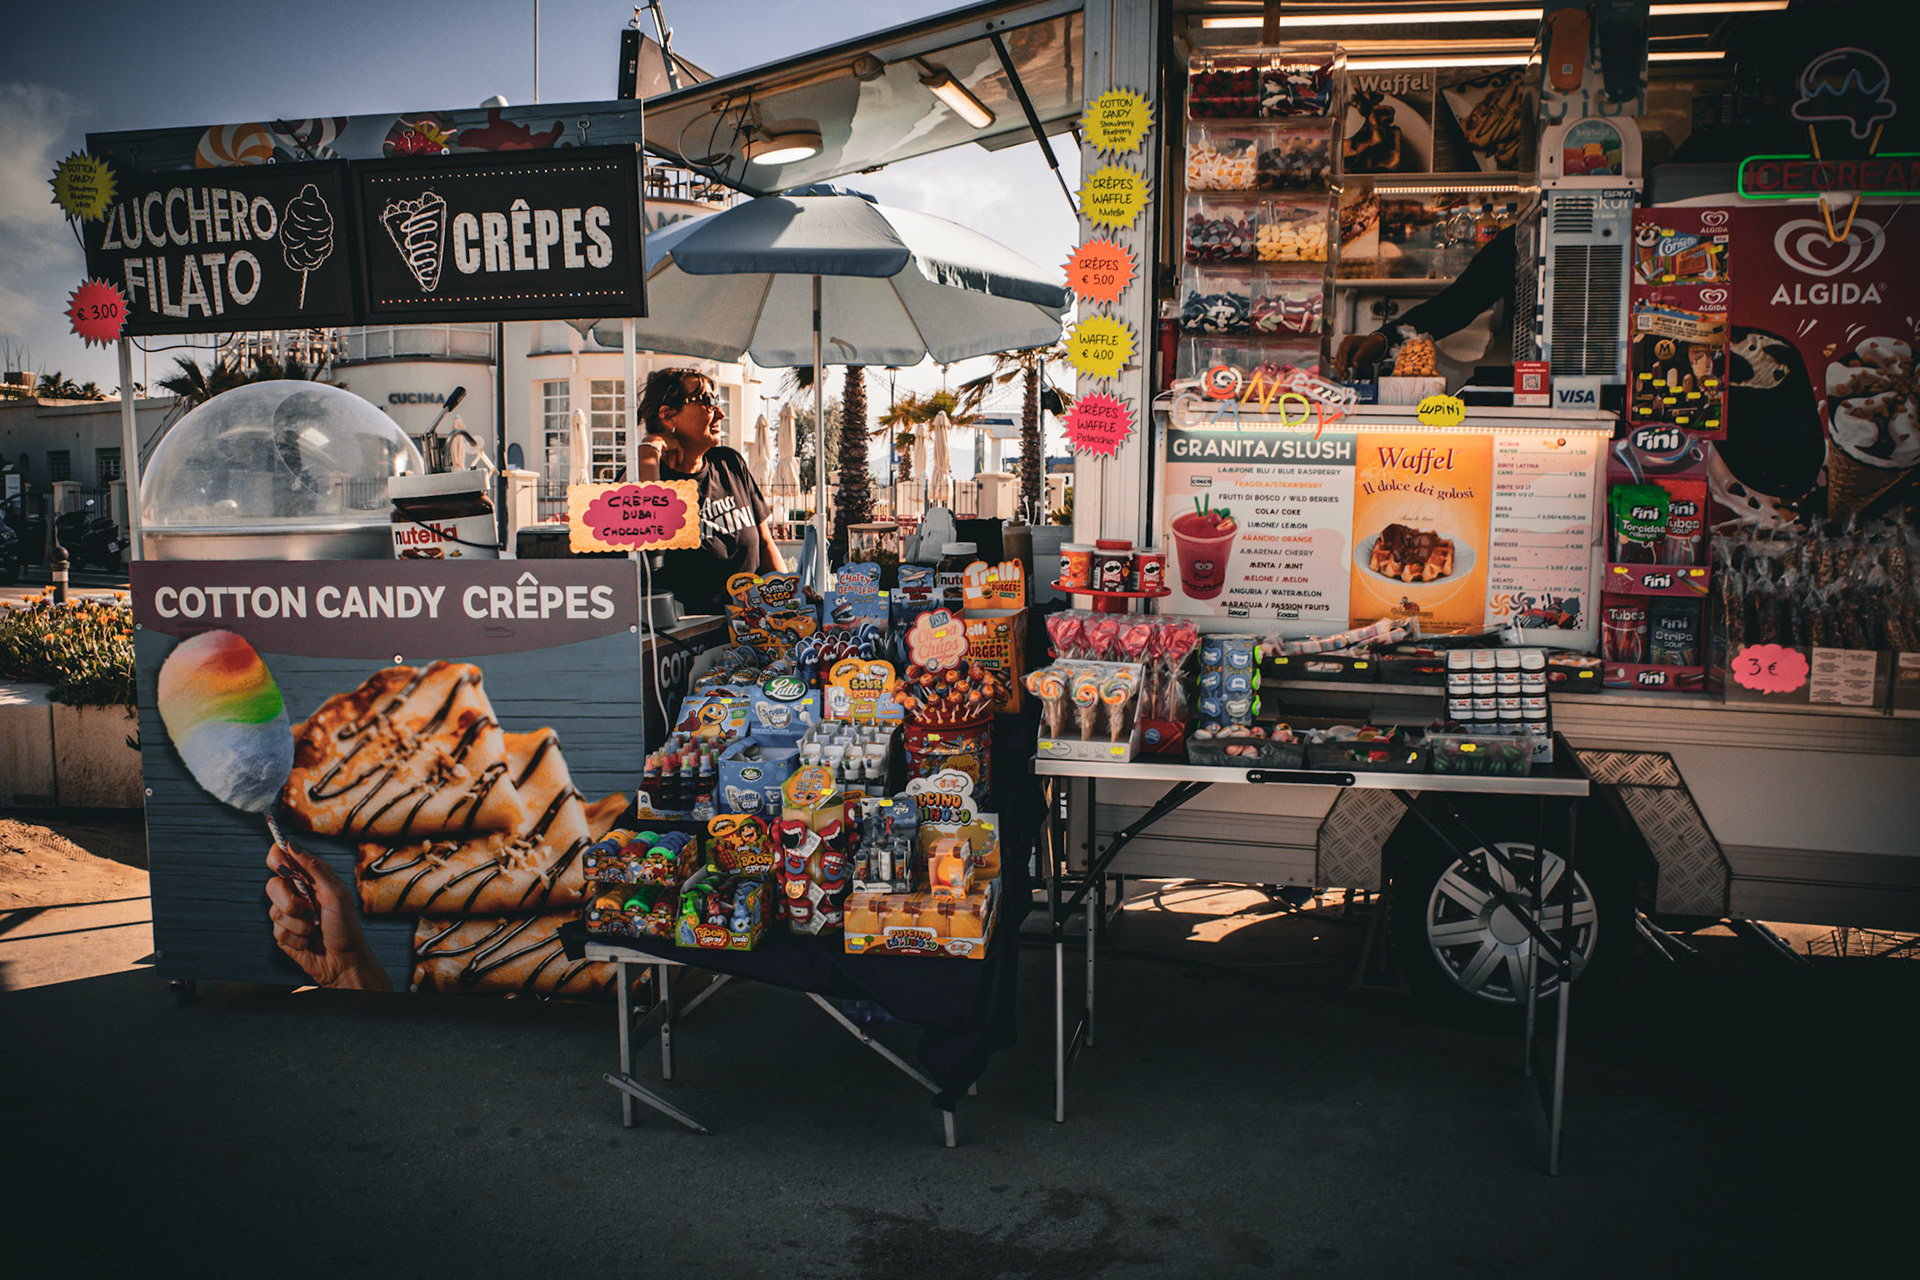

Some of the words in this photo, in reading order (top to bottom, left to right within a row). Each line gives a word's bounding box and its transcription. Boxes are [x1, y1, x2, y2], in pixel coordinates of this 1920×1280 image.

[1357, 74, 1429, 101] Waffel
[1100, 98, 1133, 109] COTTON
[1102, 108, 1131, 119] CANDY
[1099, 120, 1134, 129] Strawberry
[1102, 128, 1131, 137] Blueberry
[1108, 136, 1126, 144] White
[66, 163, 98, 175] COTTON
[69, 174, 96, 184] CANDY
[1093, 176, 1134, 190] CRÊPES
[1747, 161, 1803, 193] ICE
[66, 184, 99, 195] Strawberry
[1602, 189, 1633, 199] SPM
[70, 193, 97, 203] Blueberry
[1092, 193, 1133, 205] WAFFLE
[75, 200, 92, 209] White
[101, 186, 278, 251] ZUCCHERO
[1099, 208, 1125, 218] Nutella
[1700, 226, 1728, 234] ALGIDA
[452, 198, 614, 275] CRÊPES
[1658, 236, 1698, 256] Cornetto
[1079, 257, 1119, 271] CRÊPES
[122, 249, 262, 319] FILATO
[1082, 275, 1089, 285] €
[1769, 282, 1882, 306] ALGIDA
[1698, 304, 1728, 312] ALGIDA
[1079, 333, 1119, 346] WAFFLE
[1082, 350, 1089, 360] €
[388, 392, 446, 405] CUCINA
[1556, 389, 1596, 404] VISA
[1078, 403, 1119, 419] CRÊPES
[1077, 418, 1117, 433] WAFFLE
[1076, 432, 1115, 446] Pistacchio
[1637, 428, 1680, 450] Fini
[1172, 438, 1352, 461] GRANITA/SLUSH
[1376, 446, 1455, 476] Waffel
[1217, 466, 1255, 475] LAMPONE
[1256, 467, 1270, 475] BLU
[1278, 467, 1297, 475] BLUE
[1298, 468, 1342, 476] RASPBERRY
[1234, 480, 1324, 489] FRAGOLA/STRAWBERRY
[1361, 482, 1376, 495] Il
[1377, 479, 1411, 492] dolce
[1413, 482, 1435, 496] dei
[1437, 487, 1476, 502] golosi
[608, 490, 670, 508] CRÊPES
[1218, 493, 1244, 502] FRUTTI
[1245, 494, 1253, 502] DI
[1254, 494, 1280, 502] BOSCO
[1288, 495, 1308, 503] WILD
[1309, 495, 1339, 504] BERRIES
[1254, 508, 1280, 516] COLA/
[1281, 508, 1301, 516] COKE
[1631, 506, 1660, 521] Fini
[1668, 502, 1695, 516] Fini
[622, 510, 657, 521] DUBAI
[1247, 521, 1280, 529] LIMONE/
[1281, 522, 1308, 530] LEMON
[1621, 519, 1667, 534] Torcidas
[1666, 516, 1701, 529] Tubes
[394, 522, 459, 545] nutella
[602, 525, 665, 537] CHOCOLATE
[1241, 535, 1280, 543] ARANCIO/
[1281, 536, 1314, 544] ORANGE
[1239, 547, 1284, 556] AMARENA/
[1284, 548, 1314, 557] CHERRY
[1248, 561, 1276, 570] MENTA
[1284, 562, 1304, 571] MINT
[839, 573, 872, 586] CHATTY
[965, 559, 1021, 588] Trolli
[1243, 574, 1274, 583] MELONE
[1281, 575, 1309, 584] MELON
[757, 579, 796, 595] TURBO
[991, 582, 1018, 592] BURGER
[1643, 574, 1672, 588] Fini
[154, 584, 307, 619] COTTON
[315, 584, 447, 619] CANDY
[462, 570, 615, 621] CRÊPES
[837, 584, 878, 596] DENTIERA
[902, 586, 933, 594] SHARK
[1229, 587, 1263, 596] ANGURIA
[1270, 588, 1323, 598] WATERMELON
[1220, 601, 1263, 609] MARACUJA
[1270, 602, 1302, 611] PASSION
[1302, 603, 1330, 612] FRUITS
[1608, 608, 1646, 621] Tubes
[1660, 617, 1689, 630] Fini
[1655, 630, 1695, 643] Strips
[1748, 658, 1761, 676] 3
[1767, 660, 1779, 677] €
[1638, 671, 1666, 685] Fini
[765, 677, 803, 701] Lutti
[850, 679, 883, 690] SOUR
[851, 689, 881, 700] POTTY
[768, 707, 789, 716] TUBBLE
[771, 715, 788, 723] GUM
[738, 793, 759, 802] TUBBLE
[741, 800, 759, 809] GUM
[740, 854, 775, 866] BOOM
[744, 864, 772, 876] Spray
[696, 927, 726, 939] BOOM
[889, 928, 933, 941] PULCINO
[701, 936, 723, 946] Spray
[886, 937, 938, 951] LUMINOSO
